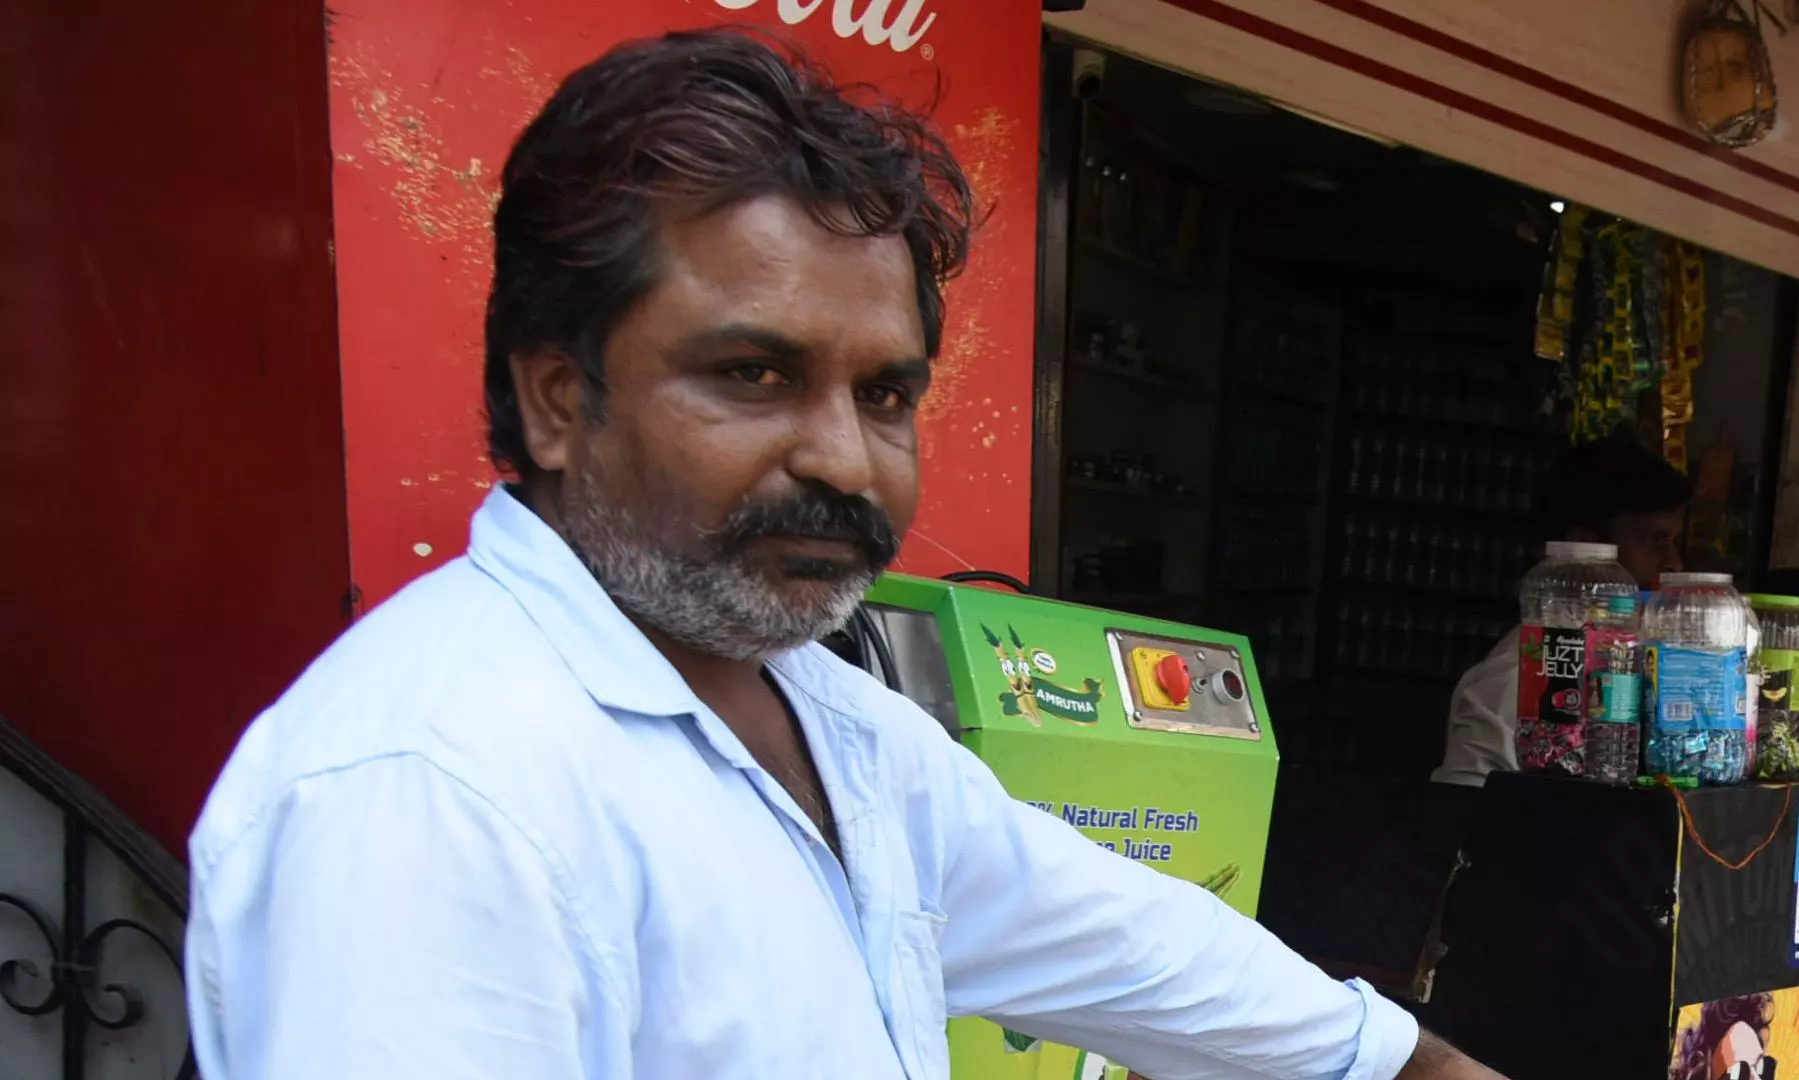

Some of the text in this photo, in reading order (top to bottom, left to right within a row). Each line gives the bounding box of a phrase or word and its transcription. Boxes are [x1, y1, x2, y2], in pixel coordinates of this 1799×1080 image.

[1536, 660, 1584, 678] JELLY
[1036, 688, 1095, 713] AMRUTHA
[1062, 803, 1138, 830] Natural
[1143, 808, 1199, 831] Fresh
[1123, 837, 1172, 861] Juice
